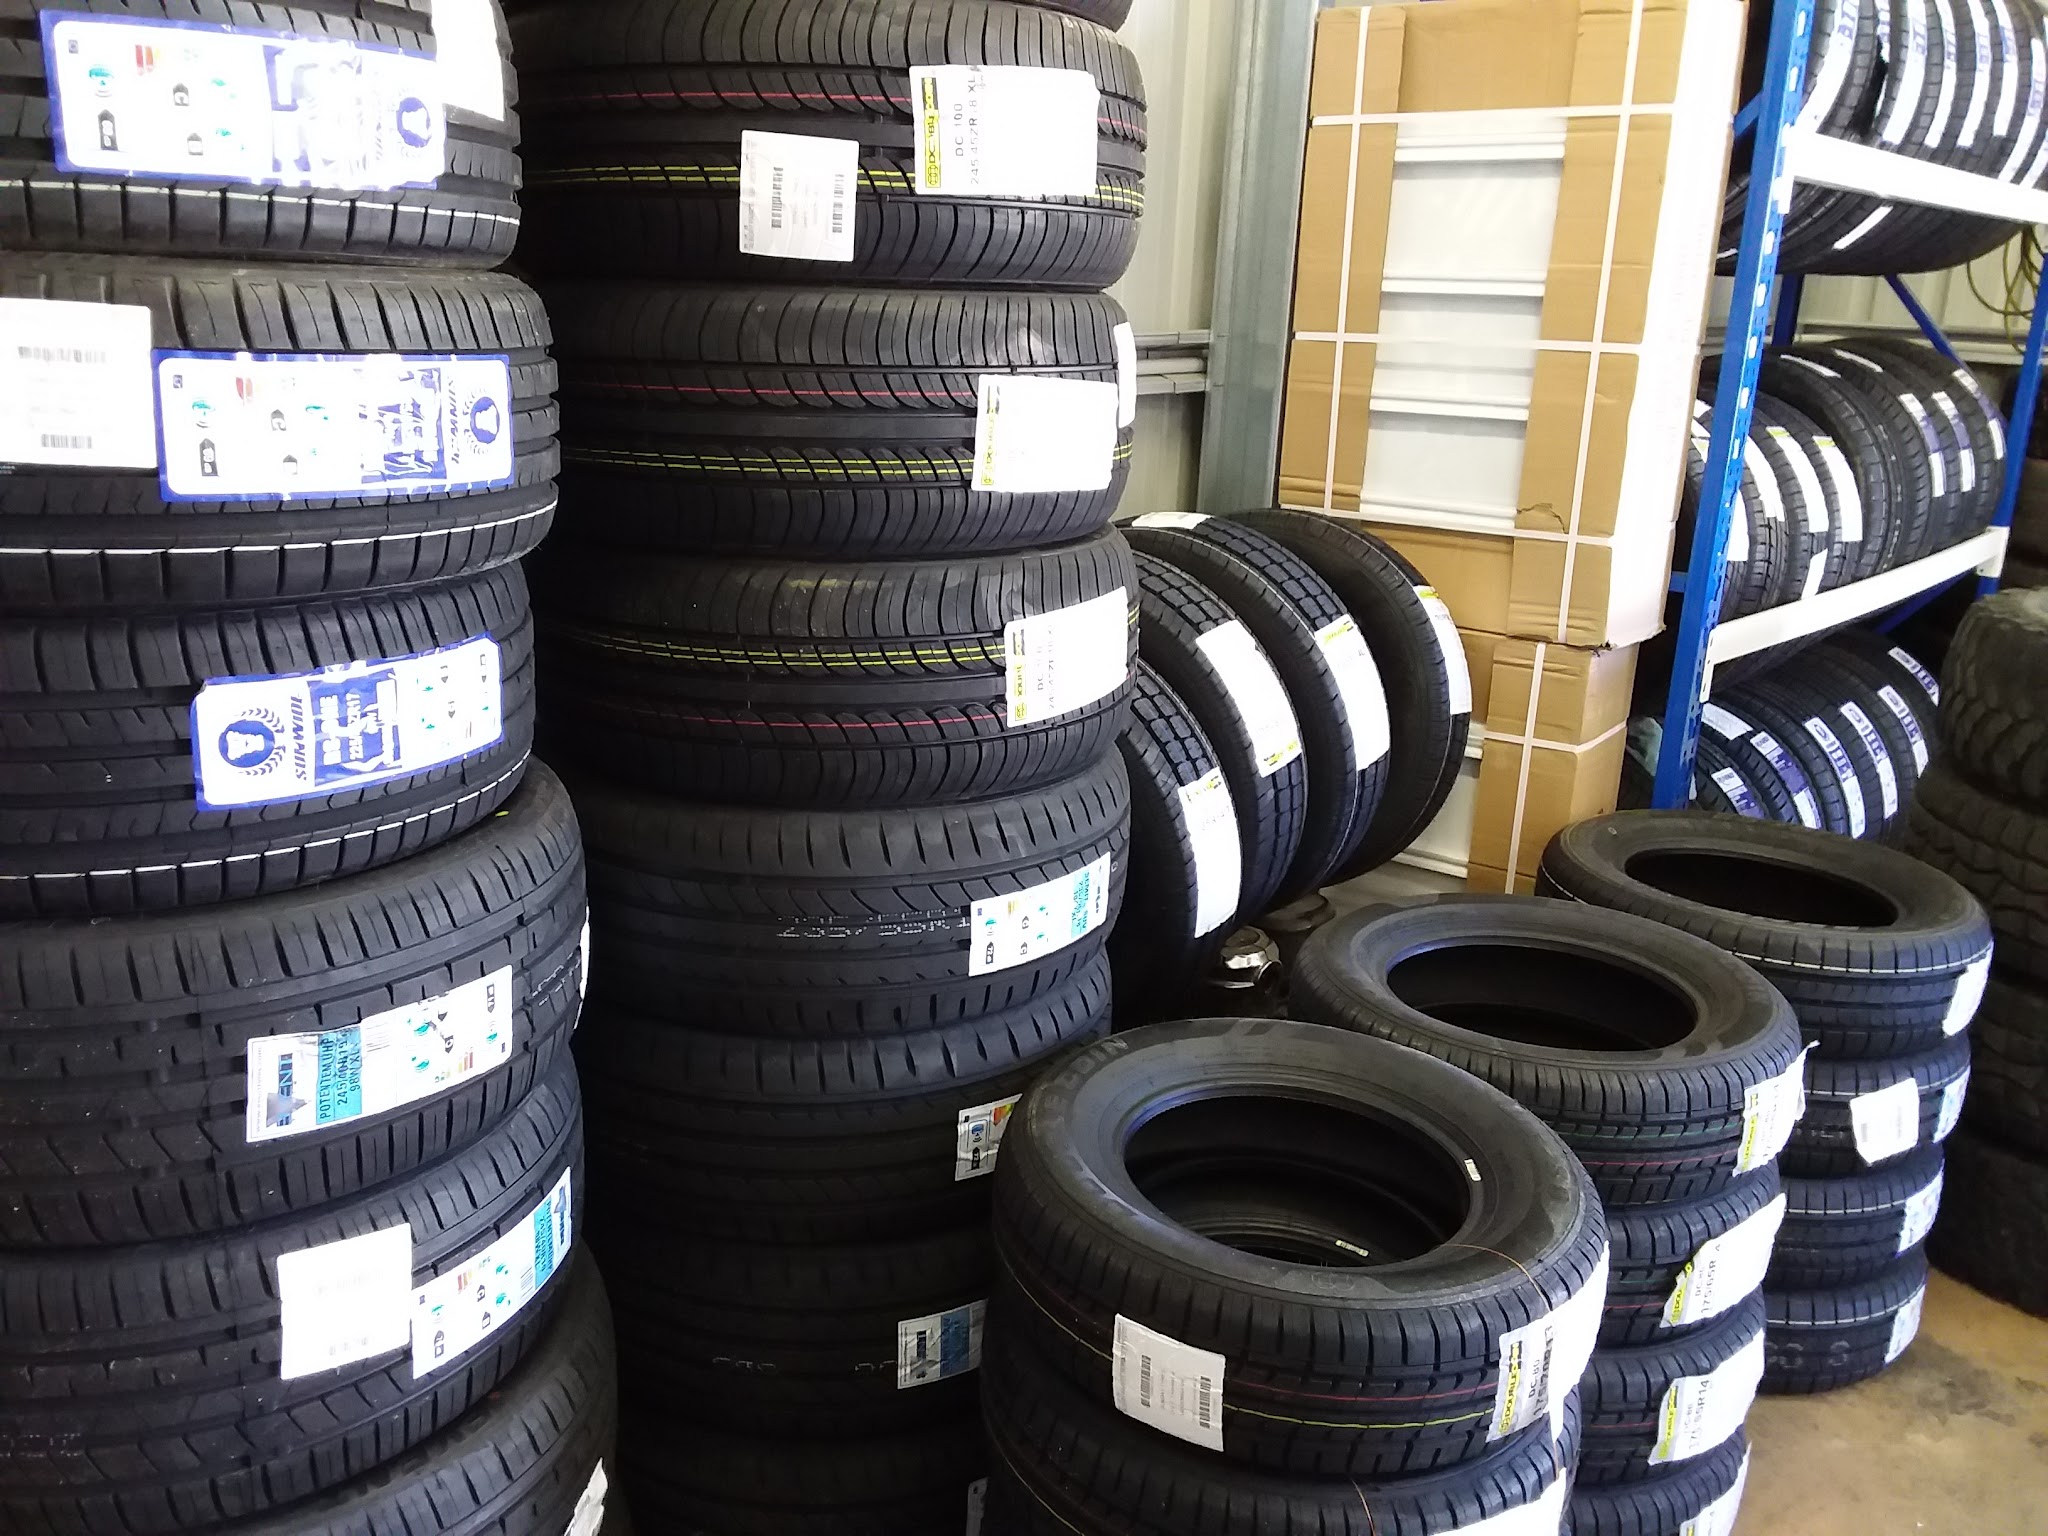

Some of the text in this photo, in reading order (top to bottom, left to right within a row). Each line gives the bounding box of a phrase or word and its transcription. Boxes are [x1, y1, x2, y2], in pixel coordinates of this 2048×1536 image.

[954, 103, 963, 156] DC 100
[1701, 1244, 1720, 1313] 175/65R4
